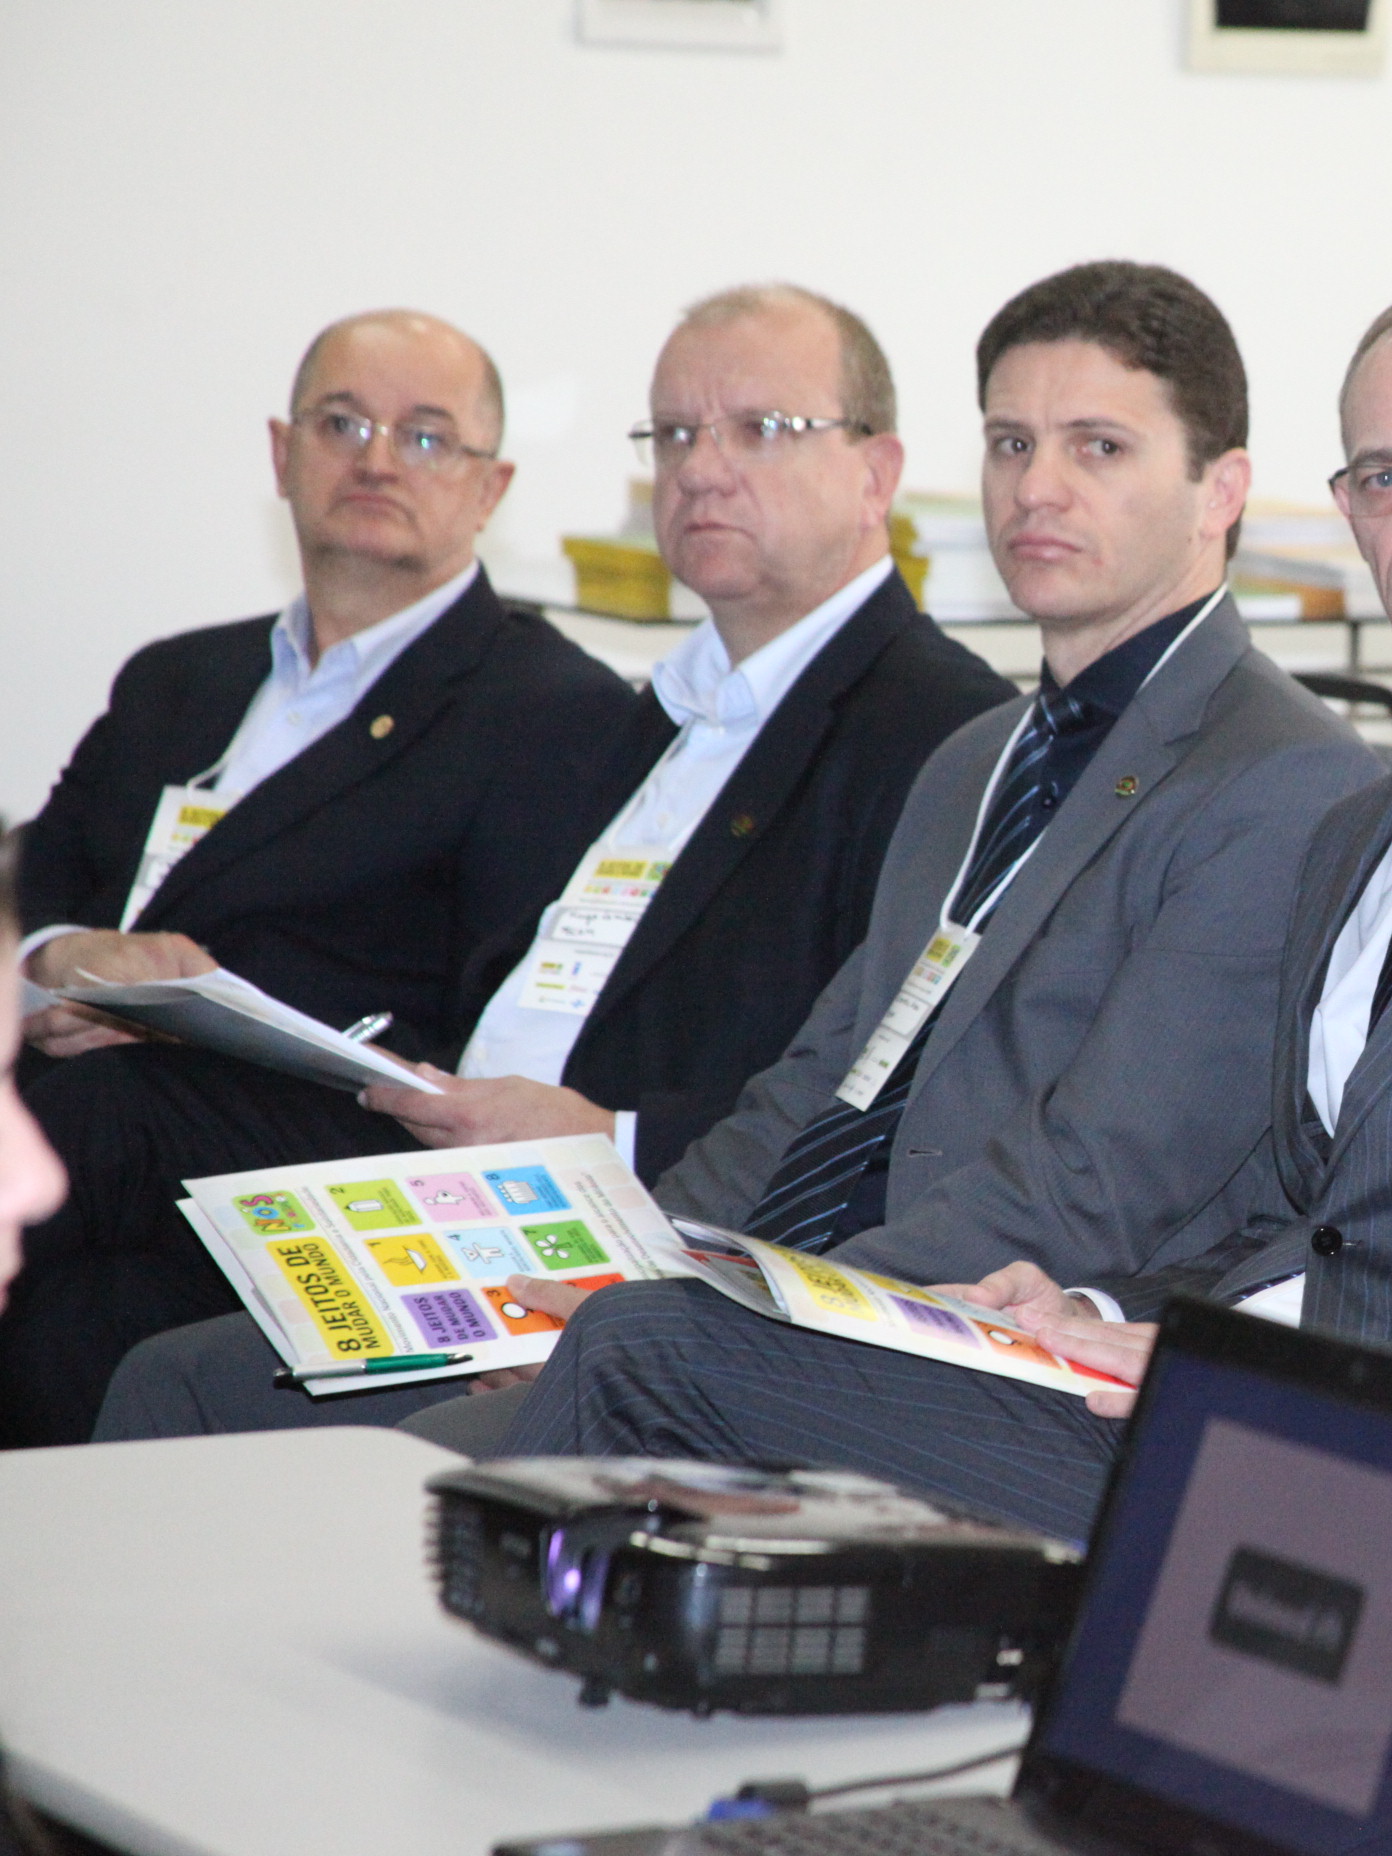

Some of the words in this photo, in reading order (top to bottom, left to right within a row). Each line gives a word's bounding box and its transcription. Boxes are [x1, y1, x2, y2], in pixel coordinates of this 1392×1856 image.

[277, 1245, 311, 1268] DE
[303, 1243, 344, 1286] MUNDO
[297, 1273, 353, 1331] JEITOS
[334, 1289, 351, 1298] O
[449, 1292, 480, 1327] MUNDO
[344, 1301, 381, 1349] MUDAR
[414, 1297, 446, 1333] JEITOS
[337, 1339, 362, 1352] 8
[454, 1328, 469, 1340] DE
